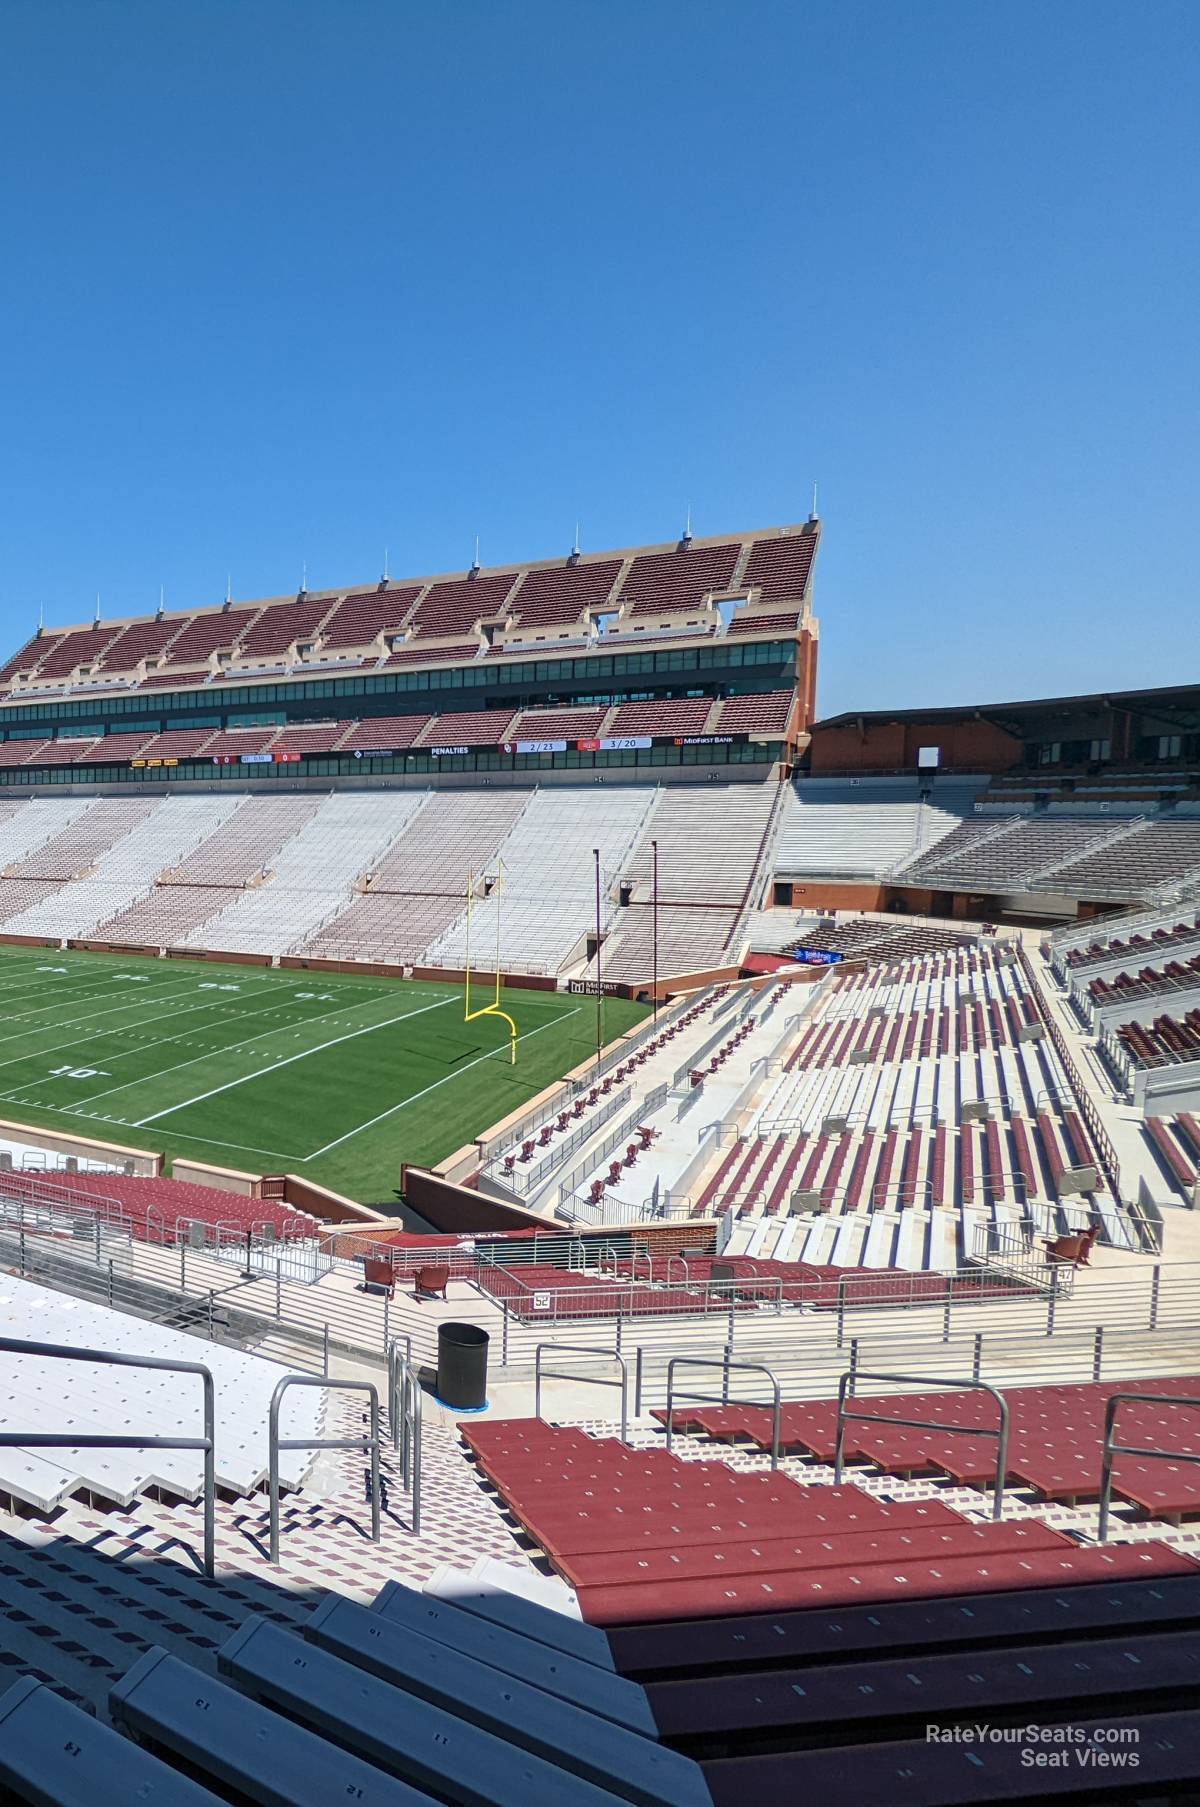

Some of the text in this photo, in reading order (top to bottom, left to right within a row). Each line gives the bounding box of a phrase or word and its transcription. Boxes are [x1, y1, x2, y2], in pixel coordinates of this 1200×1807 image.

[431, 746, 469, 755] PENALTIES
[48, 1065, 99, 1078] 10
[195, 1699, 211, 1711] 13
[346, 1784, 362, 1799] 12
